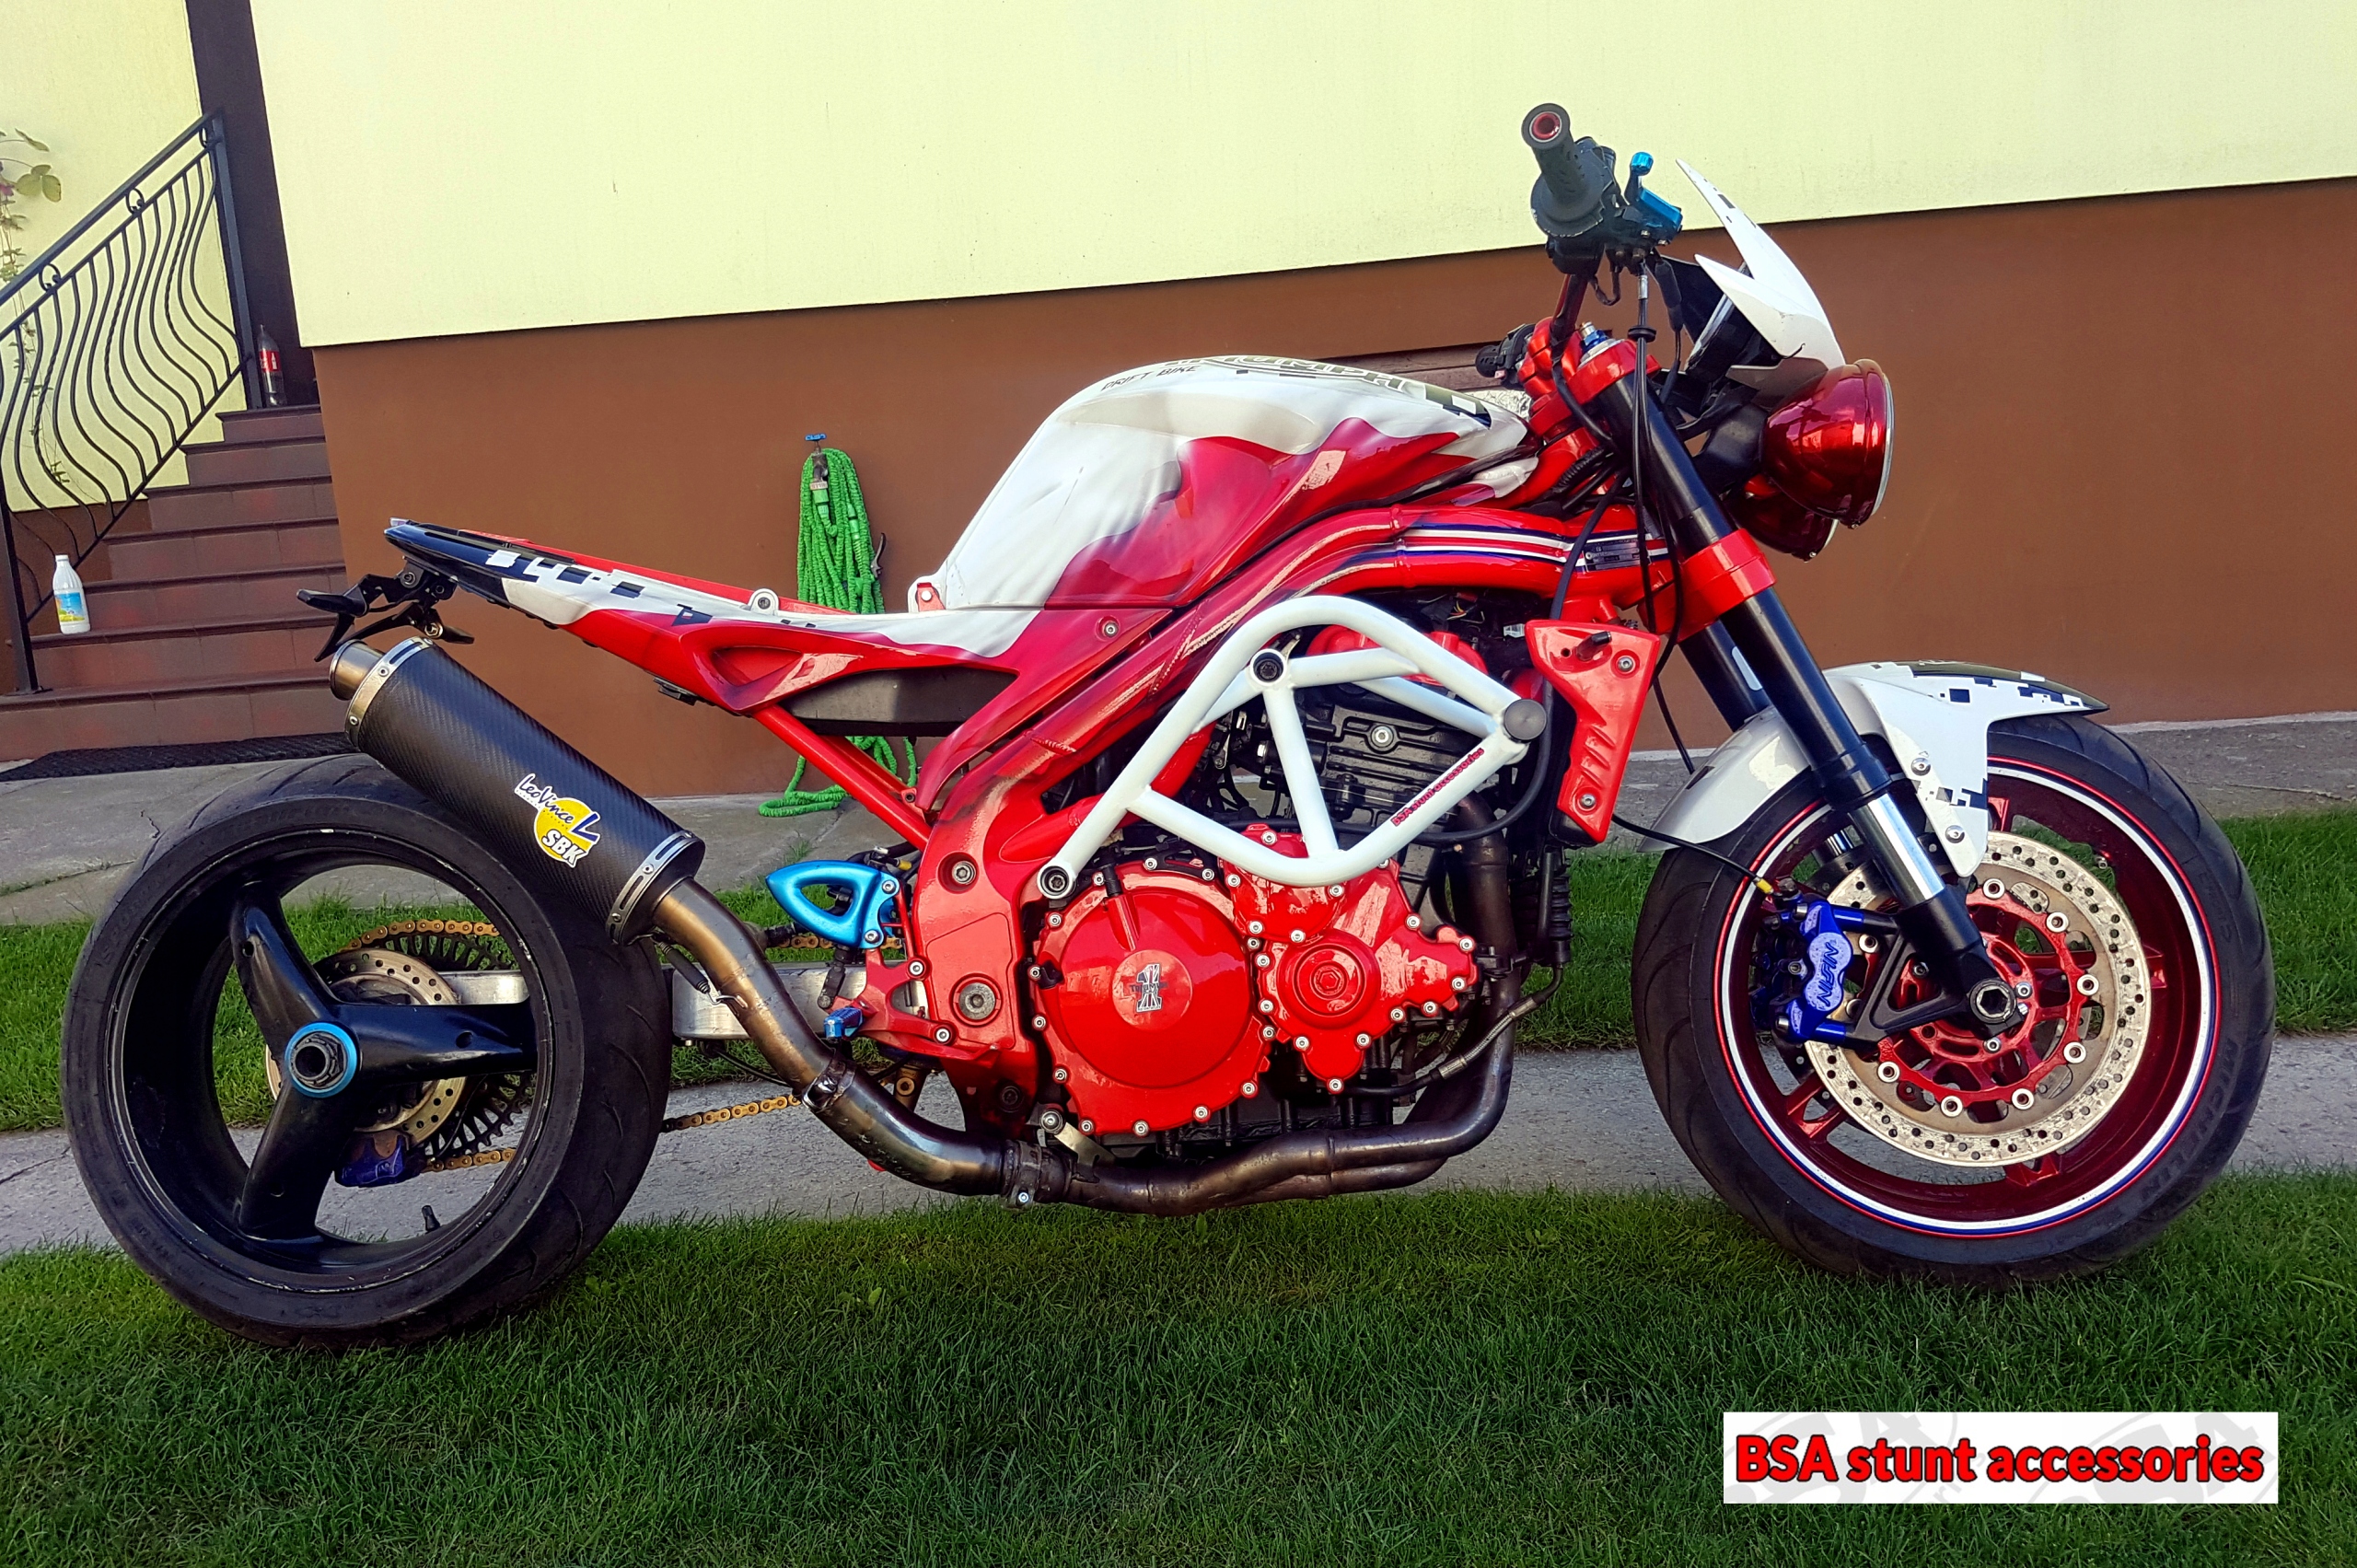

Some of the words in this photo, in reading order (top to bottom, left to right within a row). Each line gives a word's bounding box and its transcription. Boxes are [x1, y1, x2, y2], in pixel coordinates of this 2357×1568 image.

[1101, 371, 1155, 391] DRIFT
[1156, 366, 1202, 377] BIKE
[1163, 355, 1404, 393] IUMPH
[518, 775, 575, 823] LeoVince
[1391, 807, 1413, 826] BSA
[1411, 788, 1435, 811] stunt
[1434, 748, 1484, 792] accessories
[541, 829, 586, 865] SBK
